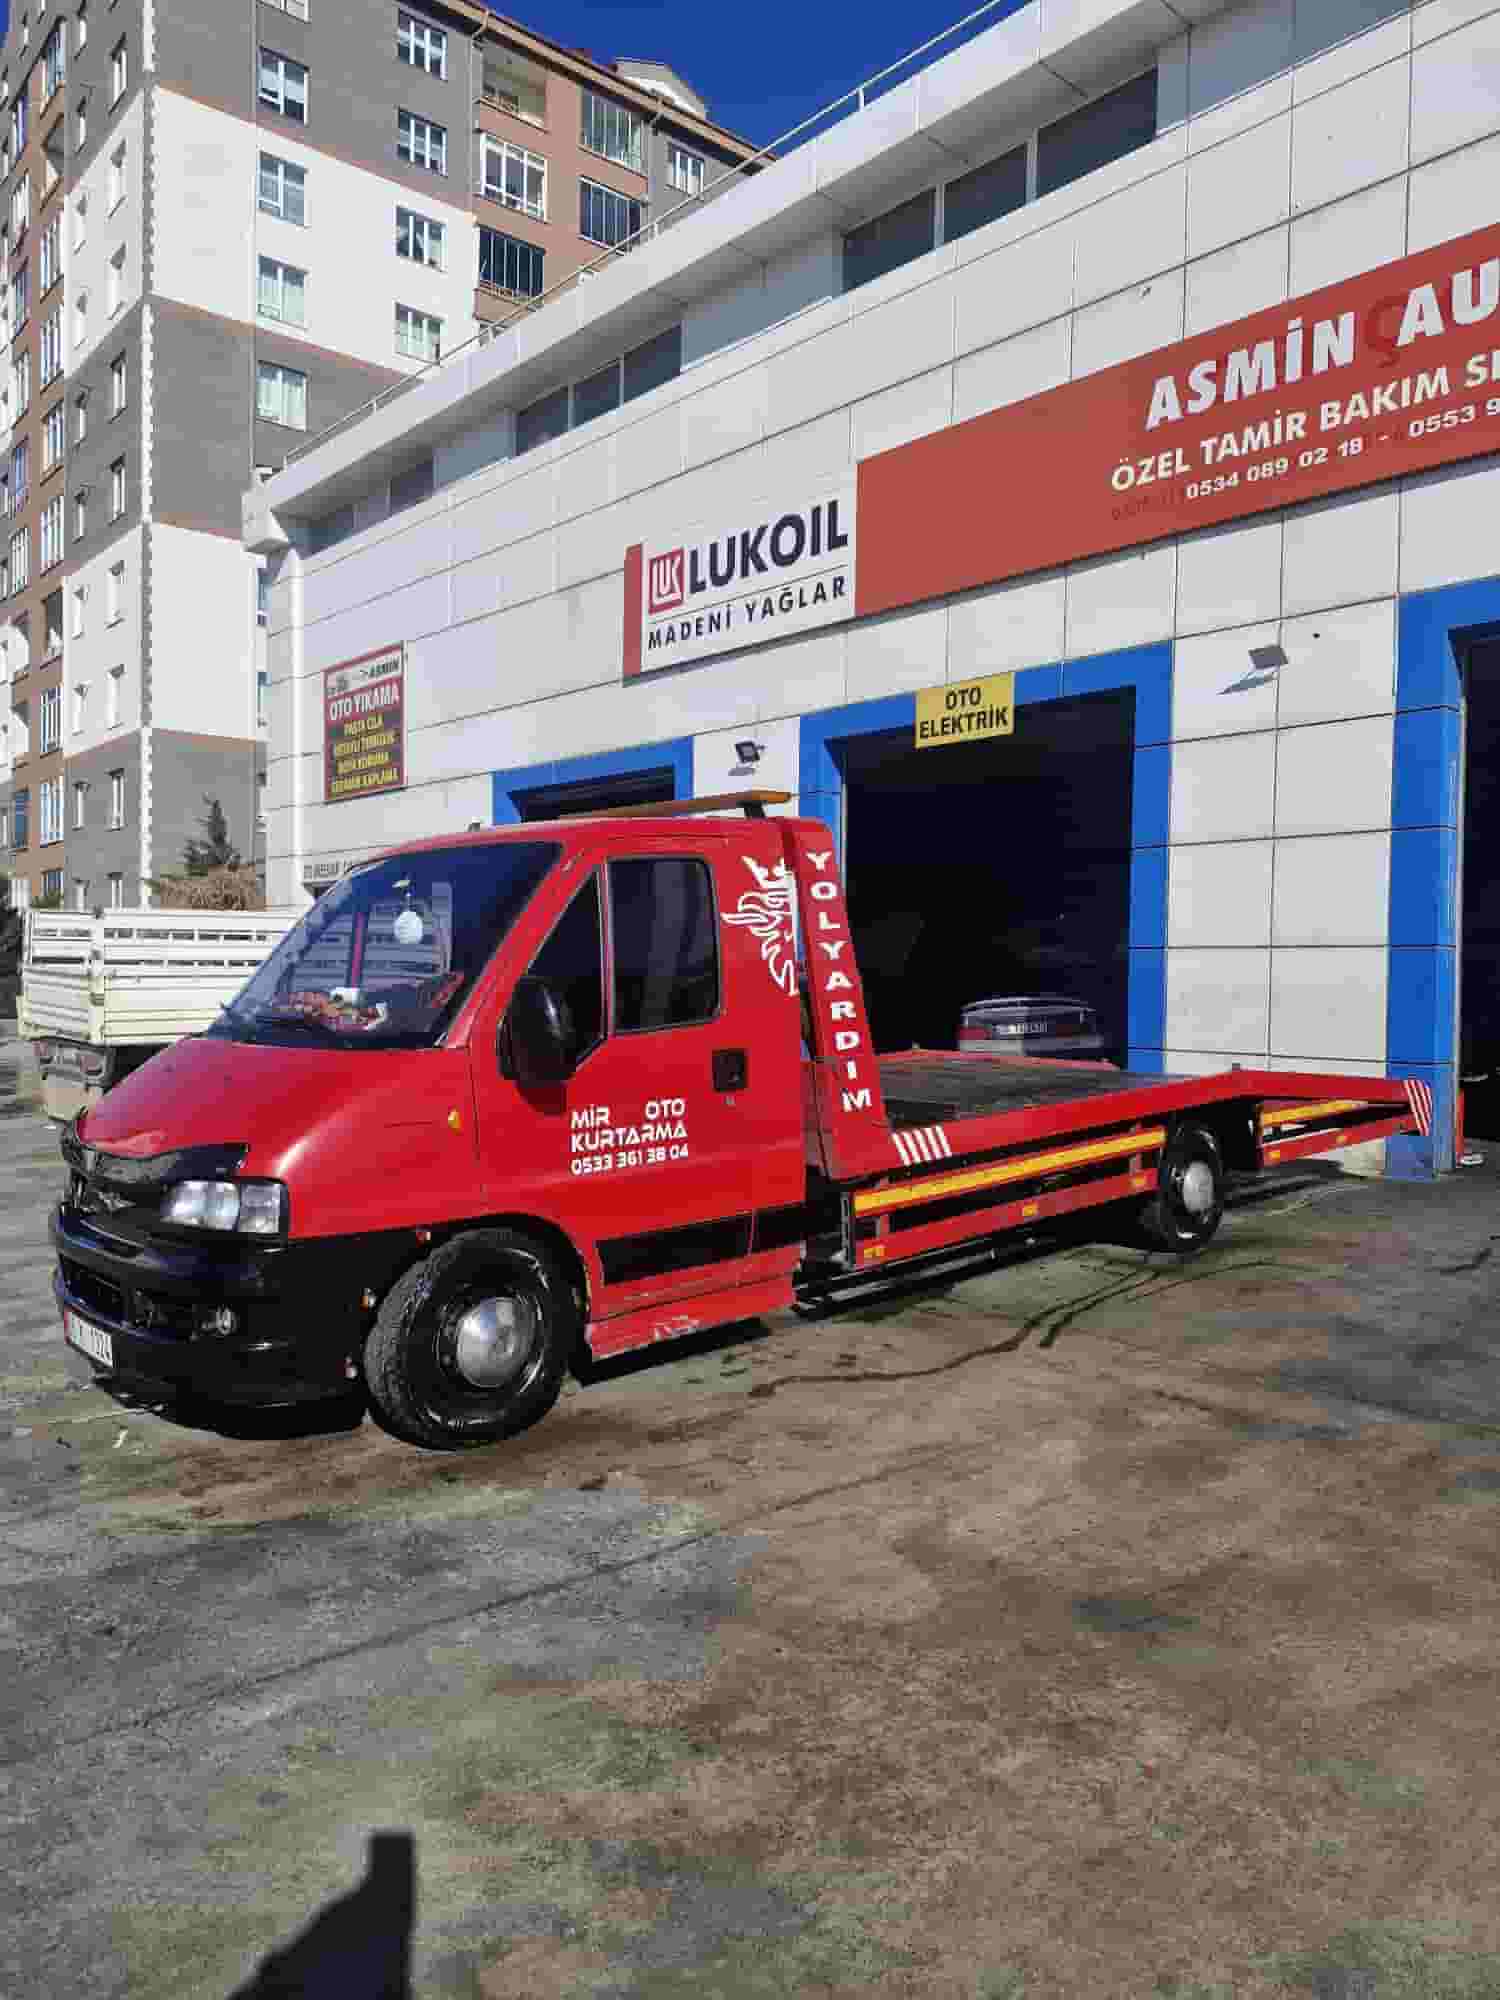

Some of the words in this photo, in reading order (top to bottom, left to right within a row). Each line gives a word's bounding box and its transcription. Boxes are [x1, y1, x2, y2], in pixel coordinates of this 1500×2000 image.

[1145, 312, 1354, 432] ASMİN
[1111, 448, 1192, 492] ÖZEL
[1200, 410, 1308, 465] TAMİR
[1319, 367, 1451, 431] BAKIM
[1186, 471, 1240, 499] 0534
[1299, 447, 1329, 469] 02
[1337, 437, 1364, 457] 18
[1408, 404, 1477, 438] 0553
[689, 499, 848, 594] LUKOIL
[648, 605, 732, 650] MADENİ
[745, 576, 847, 623] YAĞLAR
[329, 696, 352, 721] OTO
[944, 687, 982, 711] OTO
[919, 704, 1009, 740] ELEKTRİK
[570, 1105, 610, 1129] MİR
[645, 1097, 686, 1120] OTO
[570, 1120, 688, 1153] KURTARMA
[570, 1153, 613, 1176] 0533
